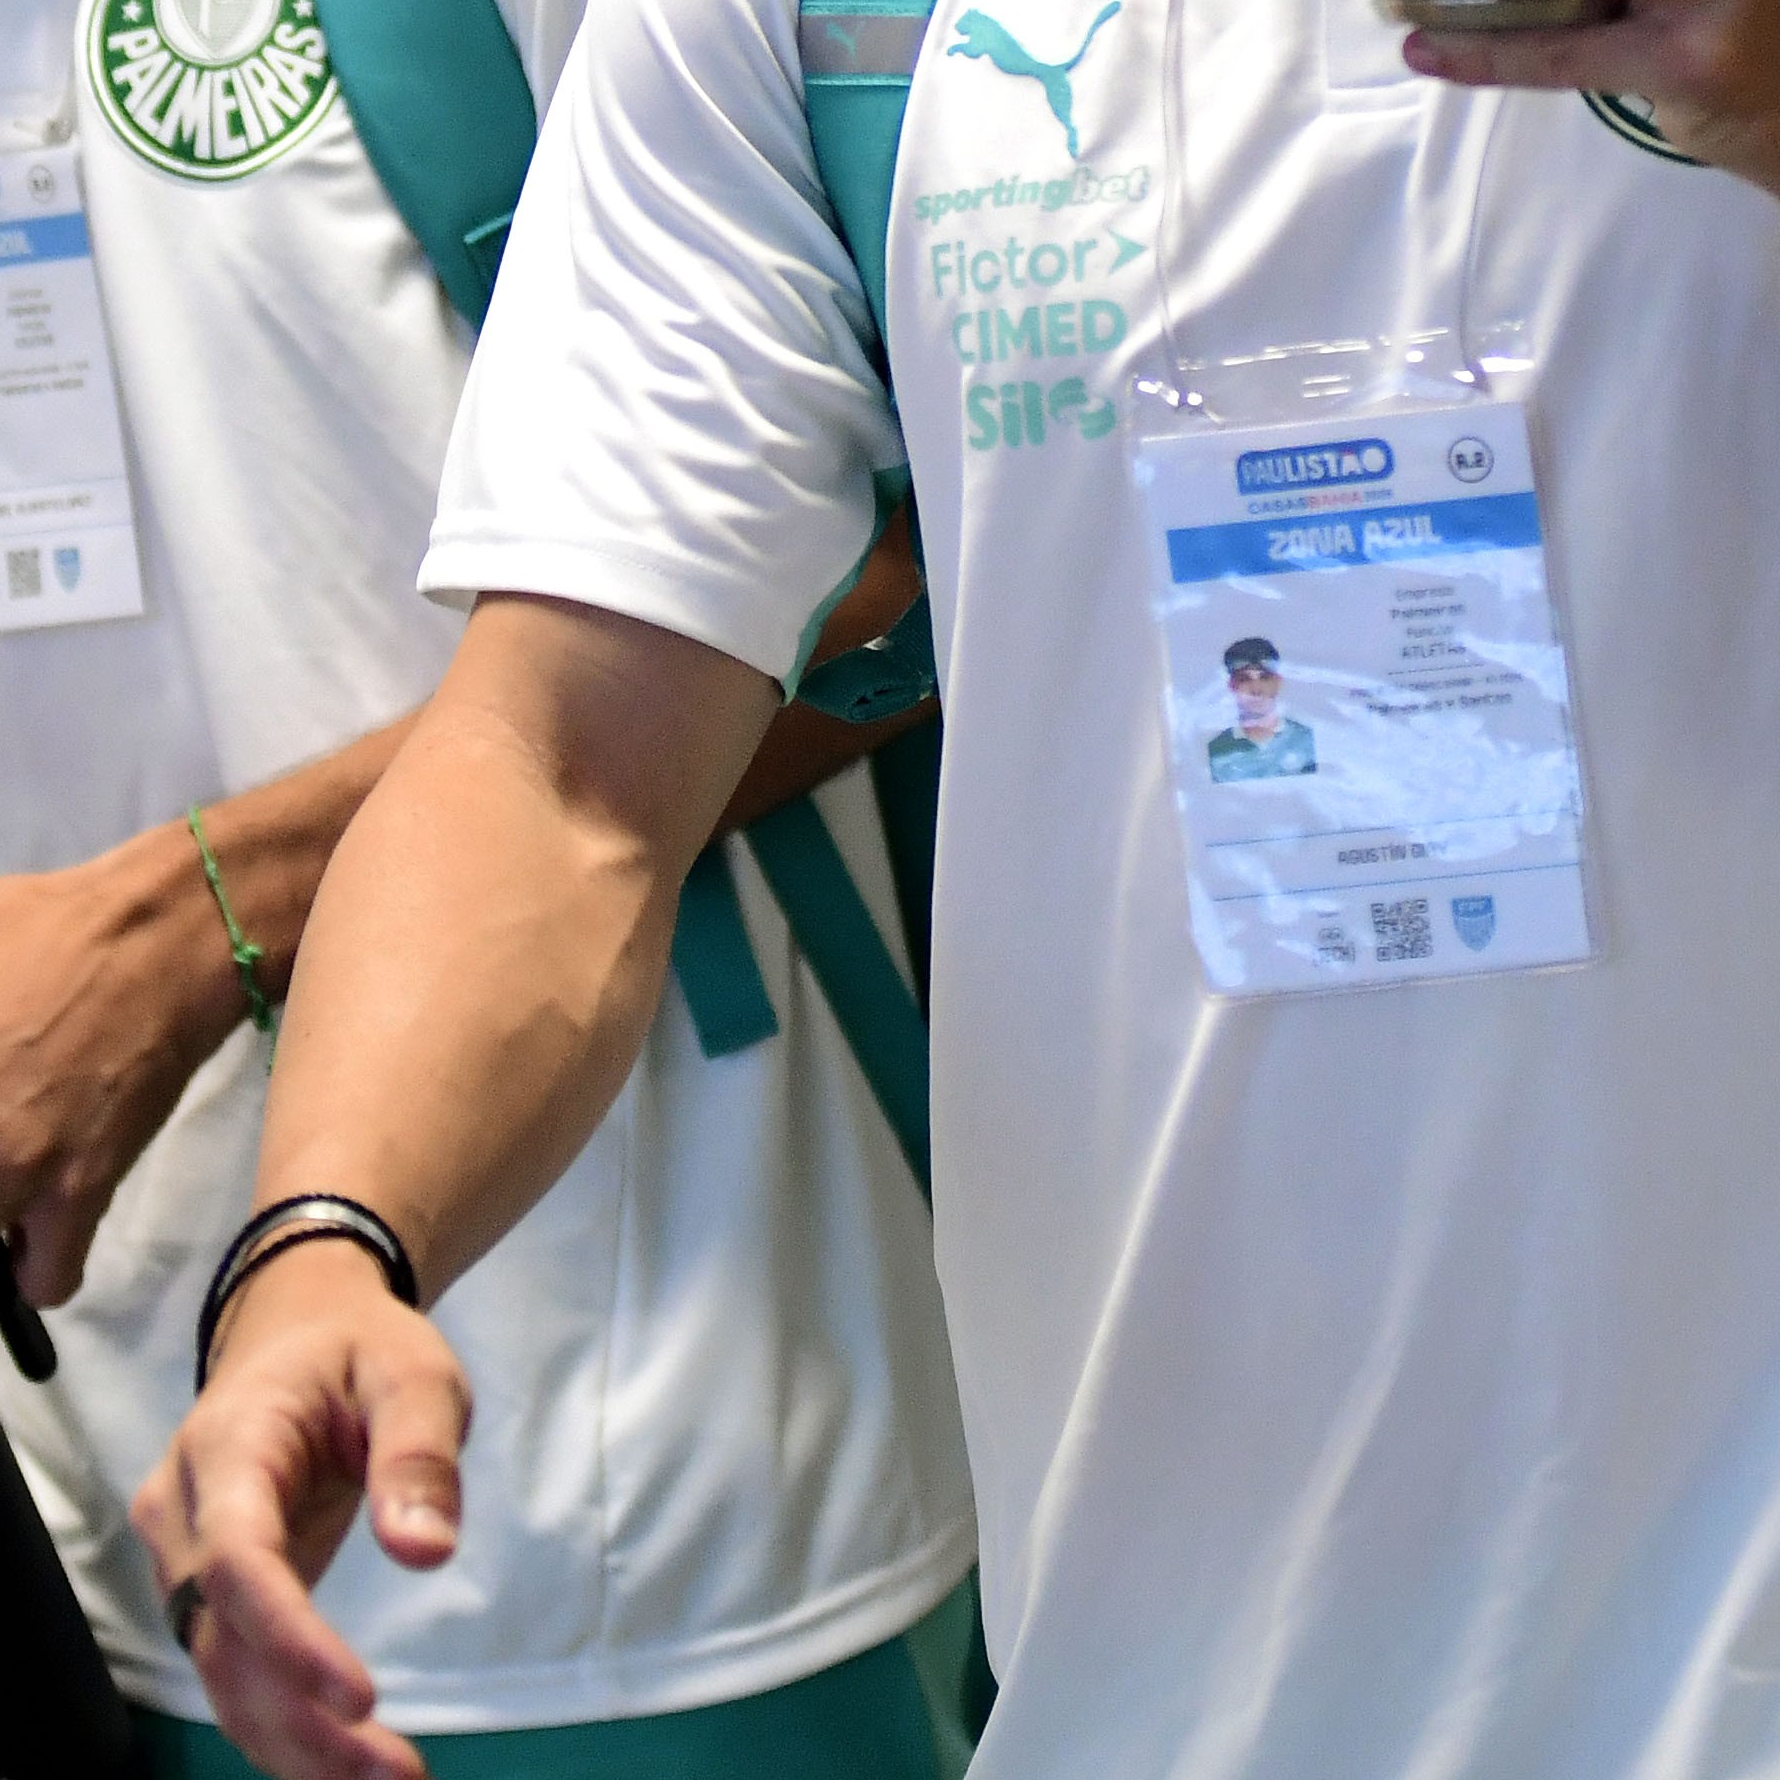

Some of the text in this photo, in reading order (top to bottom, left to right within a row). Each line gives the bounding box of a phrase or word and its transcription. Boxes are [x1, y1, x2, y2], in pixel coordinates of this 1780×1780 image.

[107, 23, 327, 160] PALMEIRAS
[931, 237, 1099, 299] Fictor
[952, 299, 1128, 365] CIMED
[1267, 515, 1442, 561] ZONA AZUL
